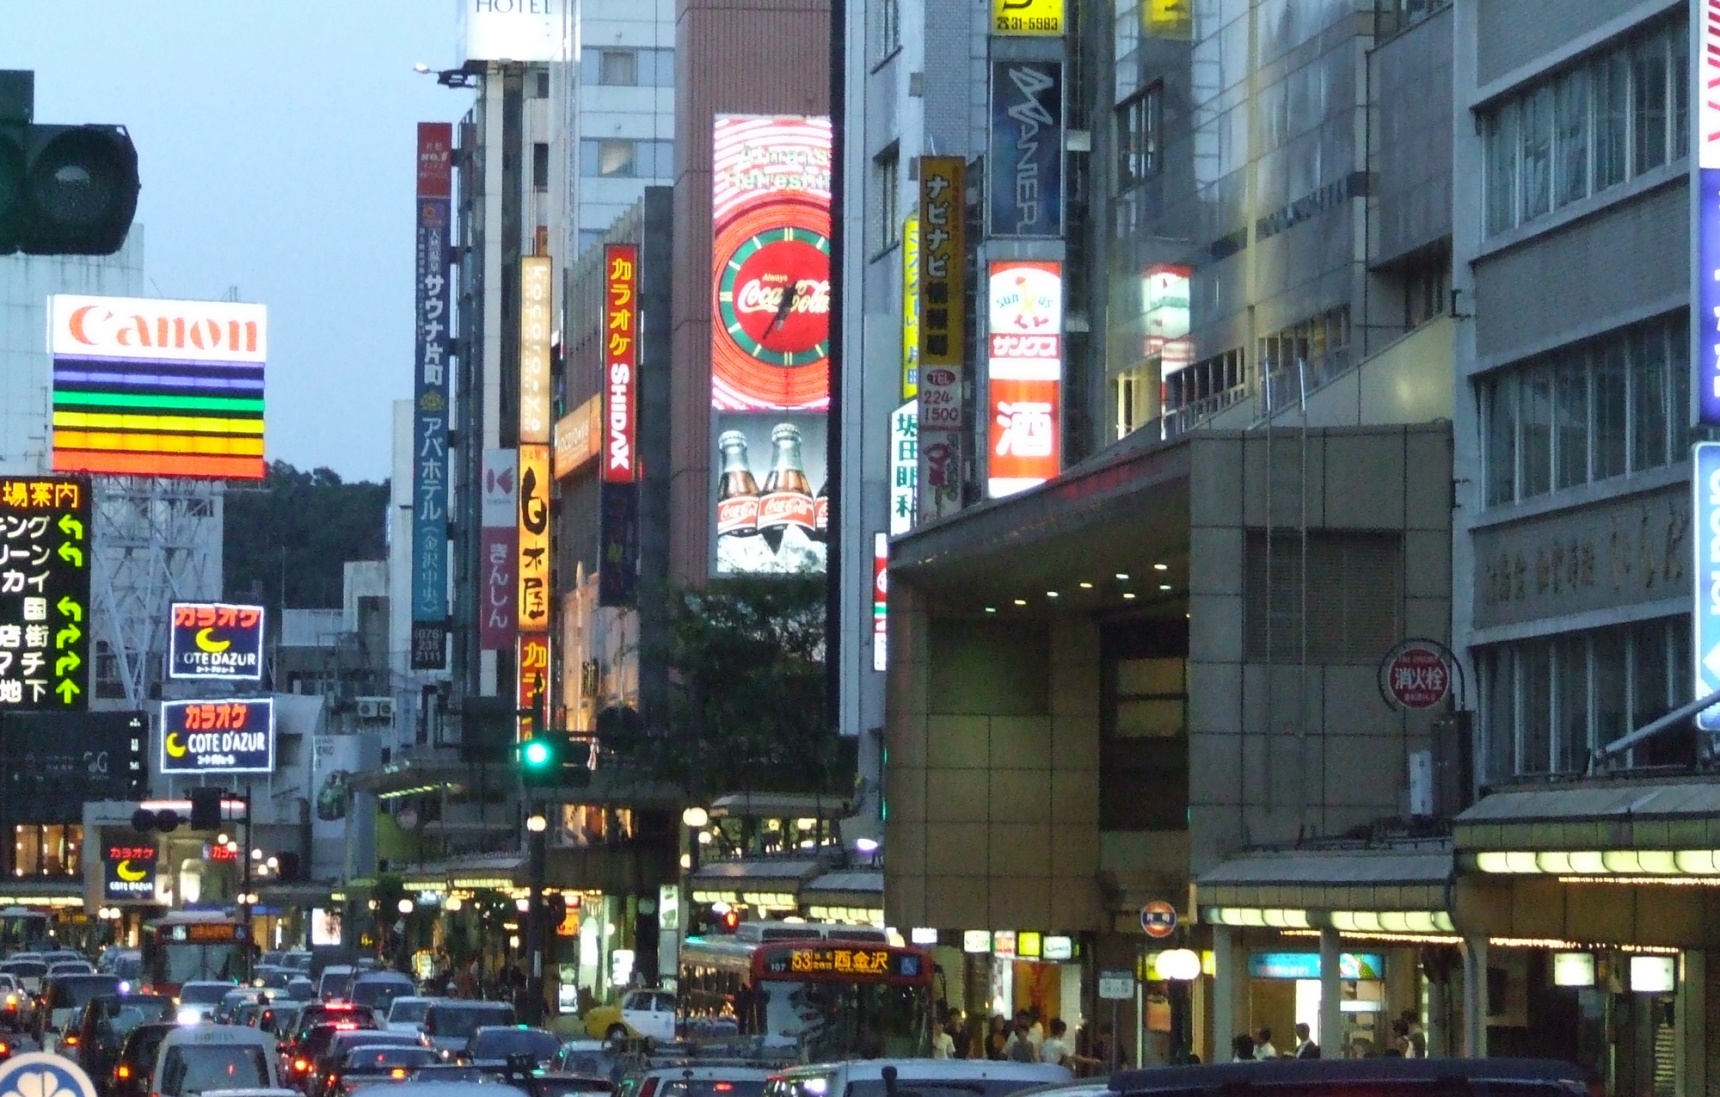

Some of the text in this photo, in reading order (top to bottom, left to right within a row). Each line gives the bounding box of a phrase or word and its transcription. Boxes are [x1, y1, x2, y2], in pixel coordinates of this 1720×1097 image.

[926, 175, 950, 278] ナビナビ
[69, 305, 257, 352] Canon
[424, 274, 444, 386] サウナ片町
[609, 258, 632, 471] カラオケ SHIDAX
[925, 407, 958, 421] 1500
[996, 401, 1053, 457] 酒
[421, 416, 442, 521] アパホテル
[489, 543, 509, 629] きんしん
[176, 607, 259, 627] カラオケ
[0, 679, 48, 702] 地下
[1394, 667, 1443, 690] 消火栓
[185, 704, 247, 729] カラオケ
[188, 731, 265, 753] COTE D'AZUR
[110, 847, 154, 859] カラオケ
[834, 950, 888, 970] 西金沢
